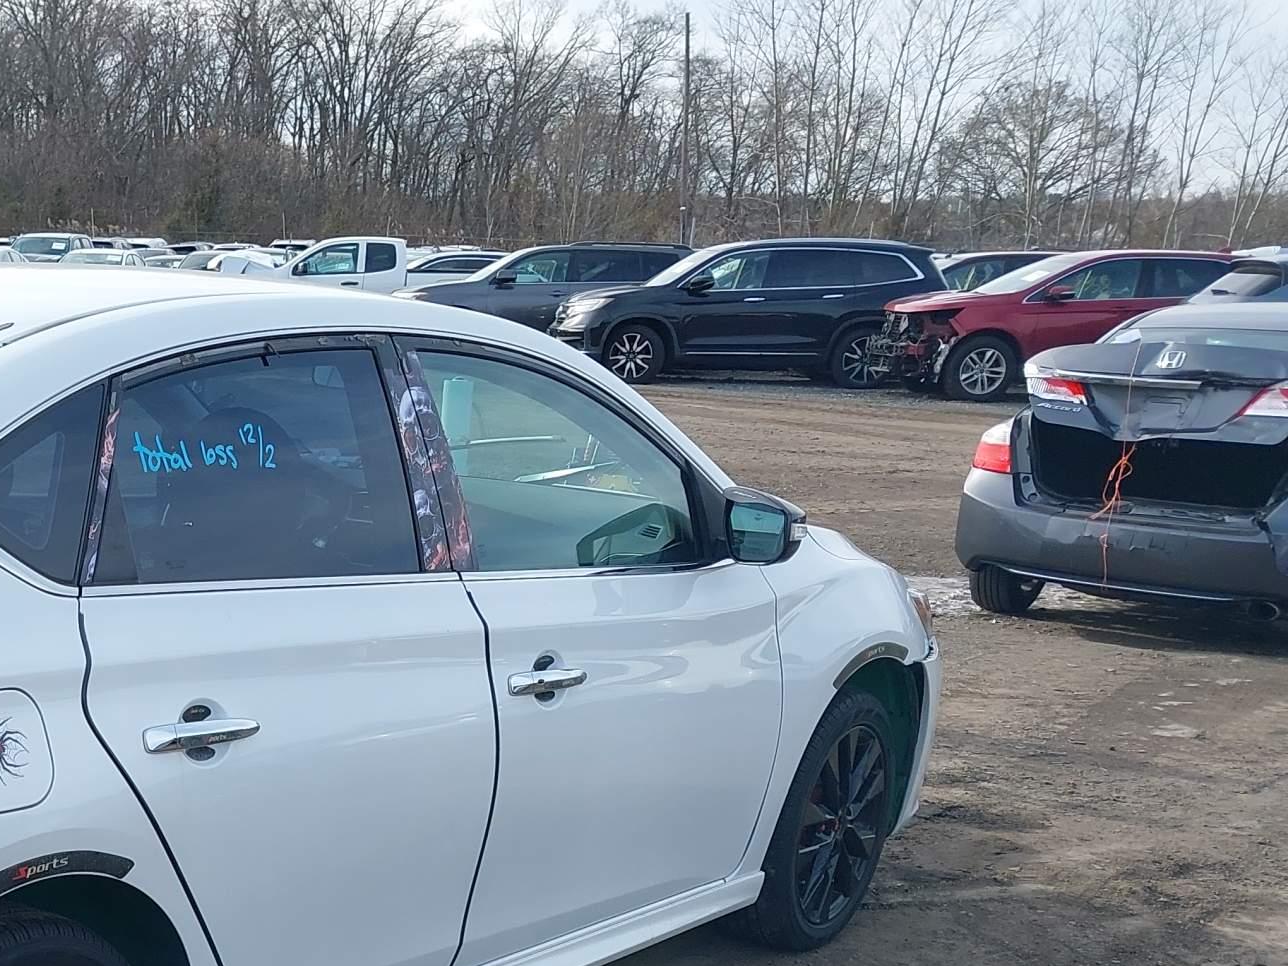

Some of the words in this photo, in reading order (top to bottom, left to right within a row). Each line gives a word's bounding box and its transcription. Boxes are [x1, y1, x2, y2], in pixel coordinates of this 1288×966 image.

[1036, 402, 1082, 413] Accord
[133, 431, 193, 473] total
[200, 440, 238, 469] loss
[239, 423, 277, 469] 12/2
[11, 856, 69, 881] Sports
